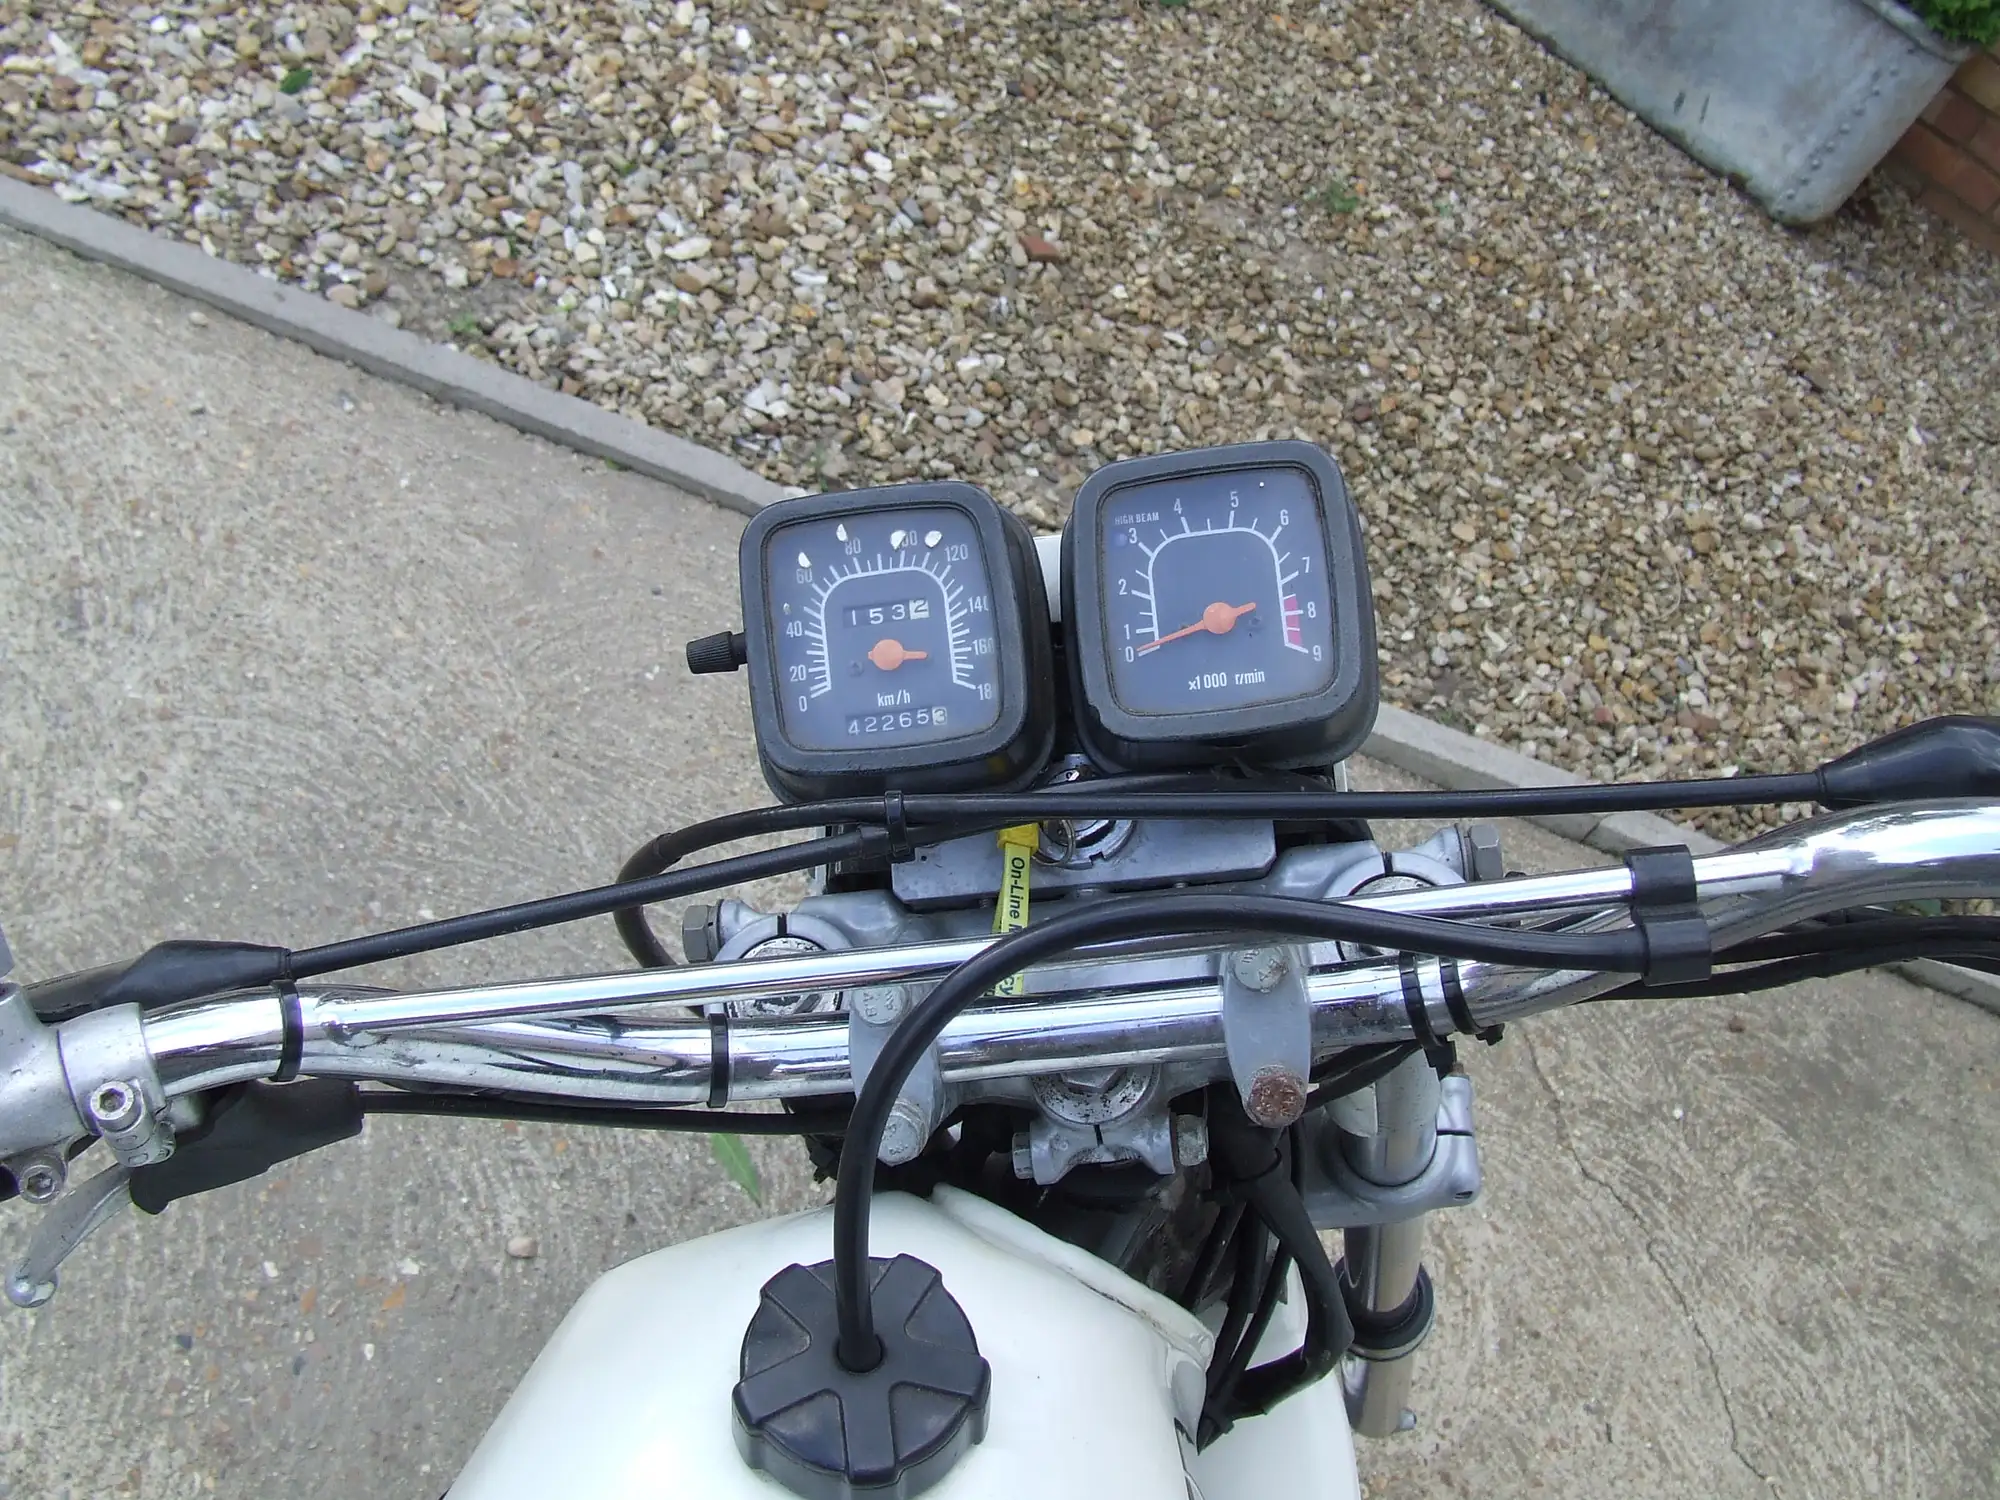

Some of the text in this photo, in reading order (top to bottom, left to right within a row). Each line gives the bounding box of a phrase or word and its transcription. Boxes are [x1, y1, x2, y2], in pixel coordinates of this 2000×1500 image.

[1173, 498, 1183, 515] 4
[1230, 491, 1240, 508] 5
[1114, 511, 1160, 525] HIGH BEAM
[1280, 509, 1290, 526] 6
[1128, 527, 1138, 544] 3
[944, 544, 969, 562] 120
[1301, 556, 1311, 574] 7
[796, 568, 813, 584] 60
[1118, 578, 1128, 596] 2
[1307, 601, 1317, 618] 8
[786, 621, 803, 637] 40
[1123, 624, 1131, 640] 1
[1125, 646, 1135, 663] 0
[1312, 645, 1322, 662] 9
[790, 665, 807, 682] 20
[1235, 668, 1265, 685] r/min
[799, 696, 808, 712] 0
[877, 689, 911, 707] km/h
[1008, 857, 1025, 919] On-Line
